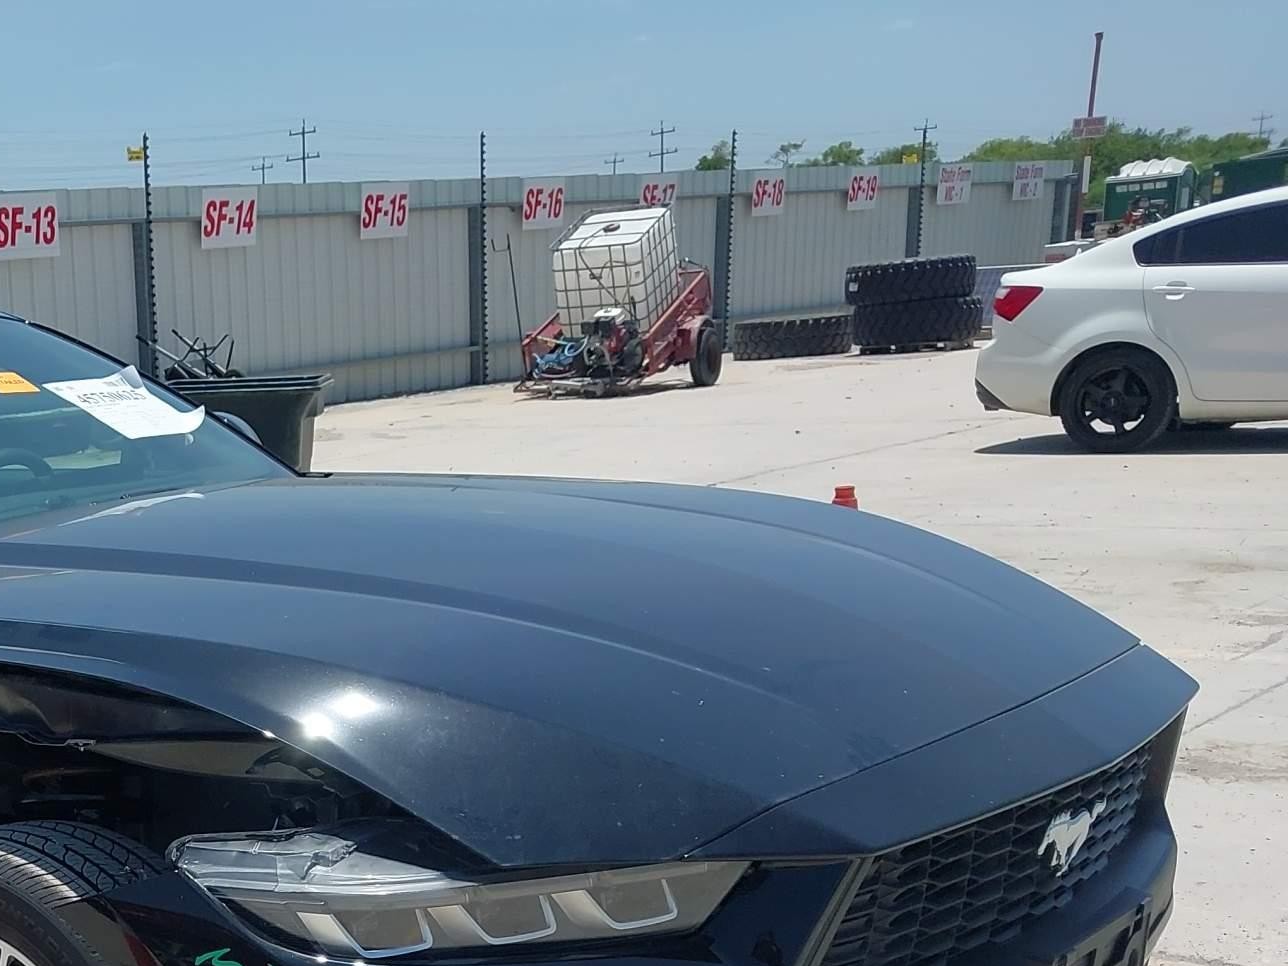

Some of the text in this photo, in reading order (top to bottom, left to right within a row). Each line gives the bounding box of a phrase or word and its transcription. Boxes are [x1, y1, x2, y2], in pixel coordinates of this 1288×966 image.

[524, 187, 564, 221] SF-16
[753, 178, 785, 208] SF-18
[849, 175, 878, 202] SF-19
[203, 199, 256, 238] SF-14
[362, 193, 408, 229] SF-15
